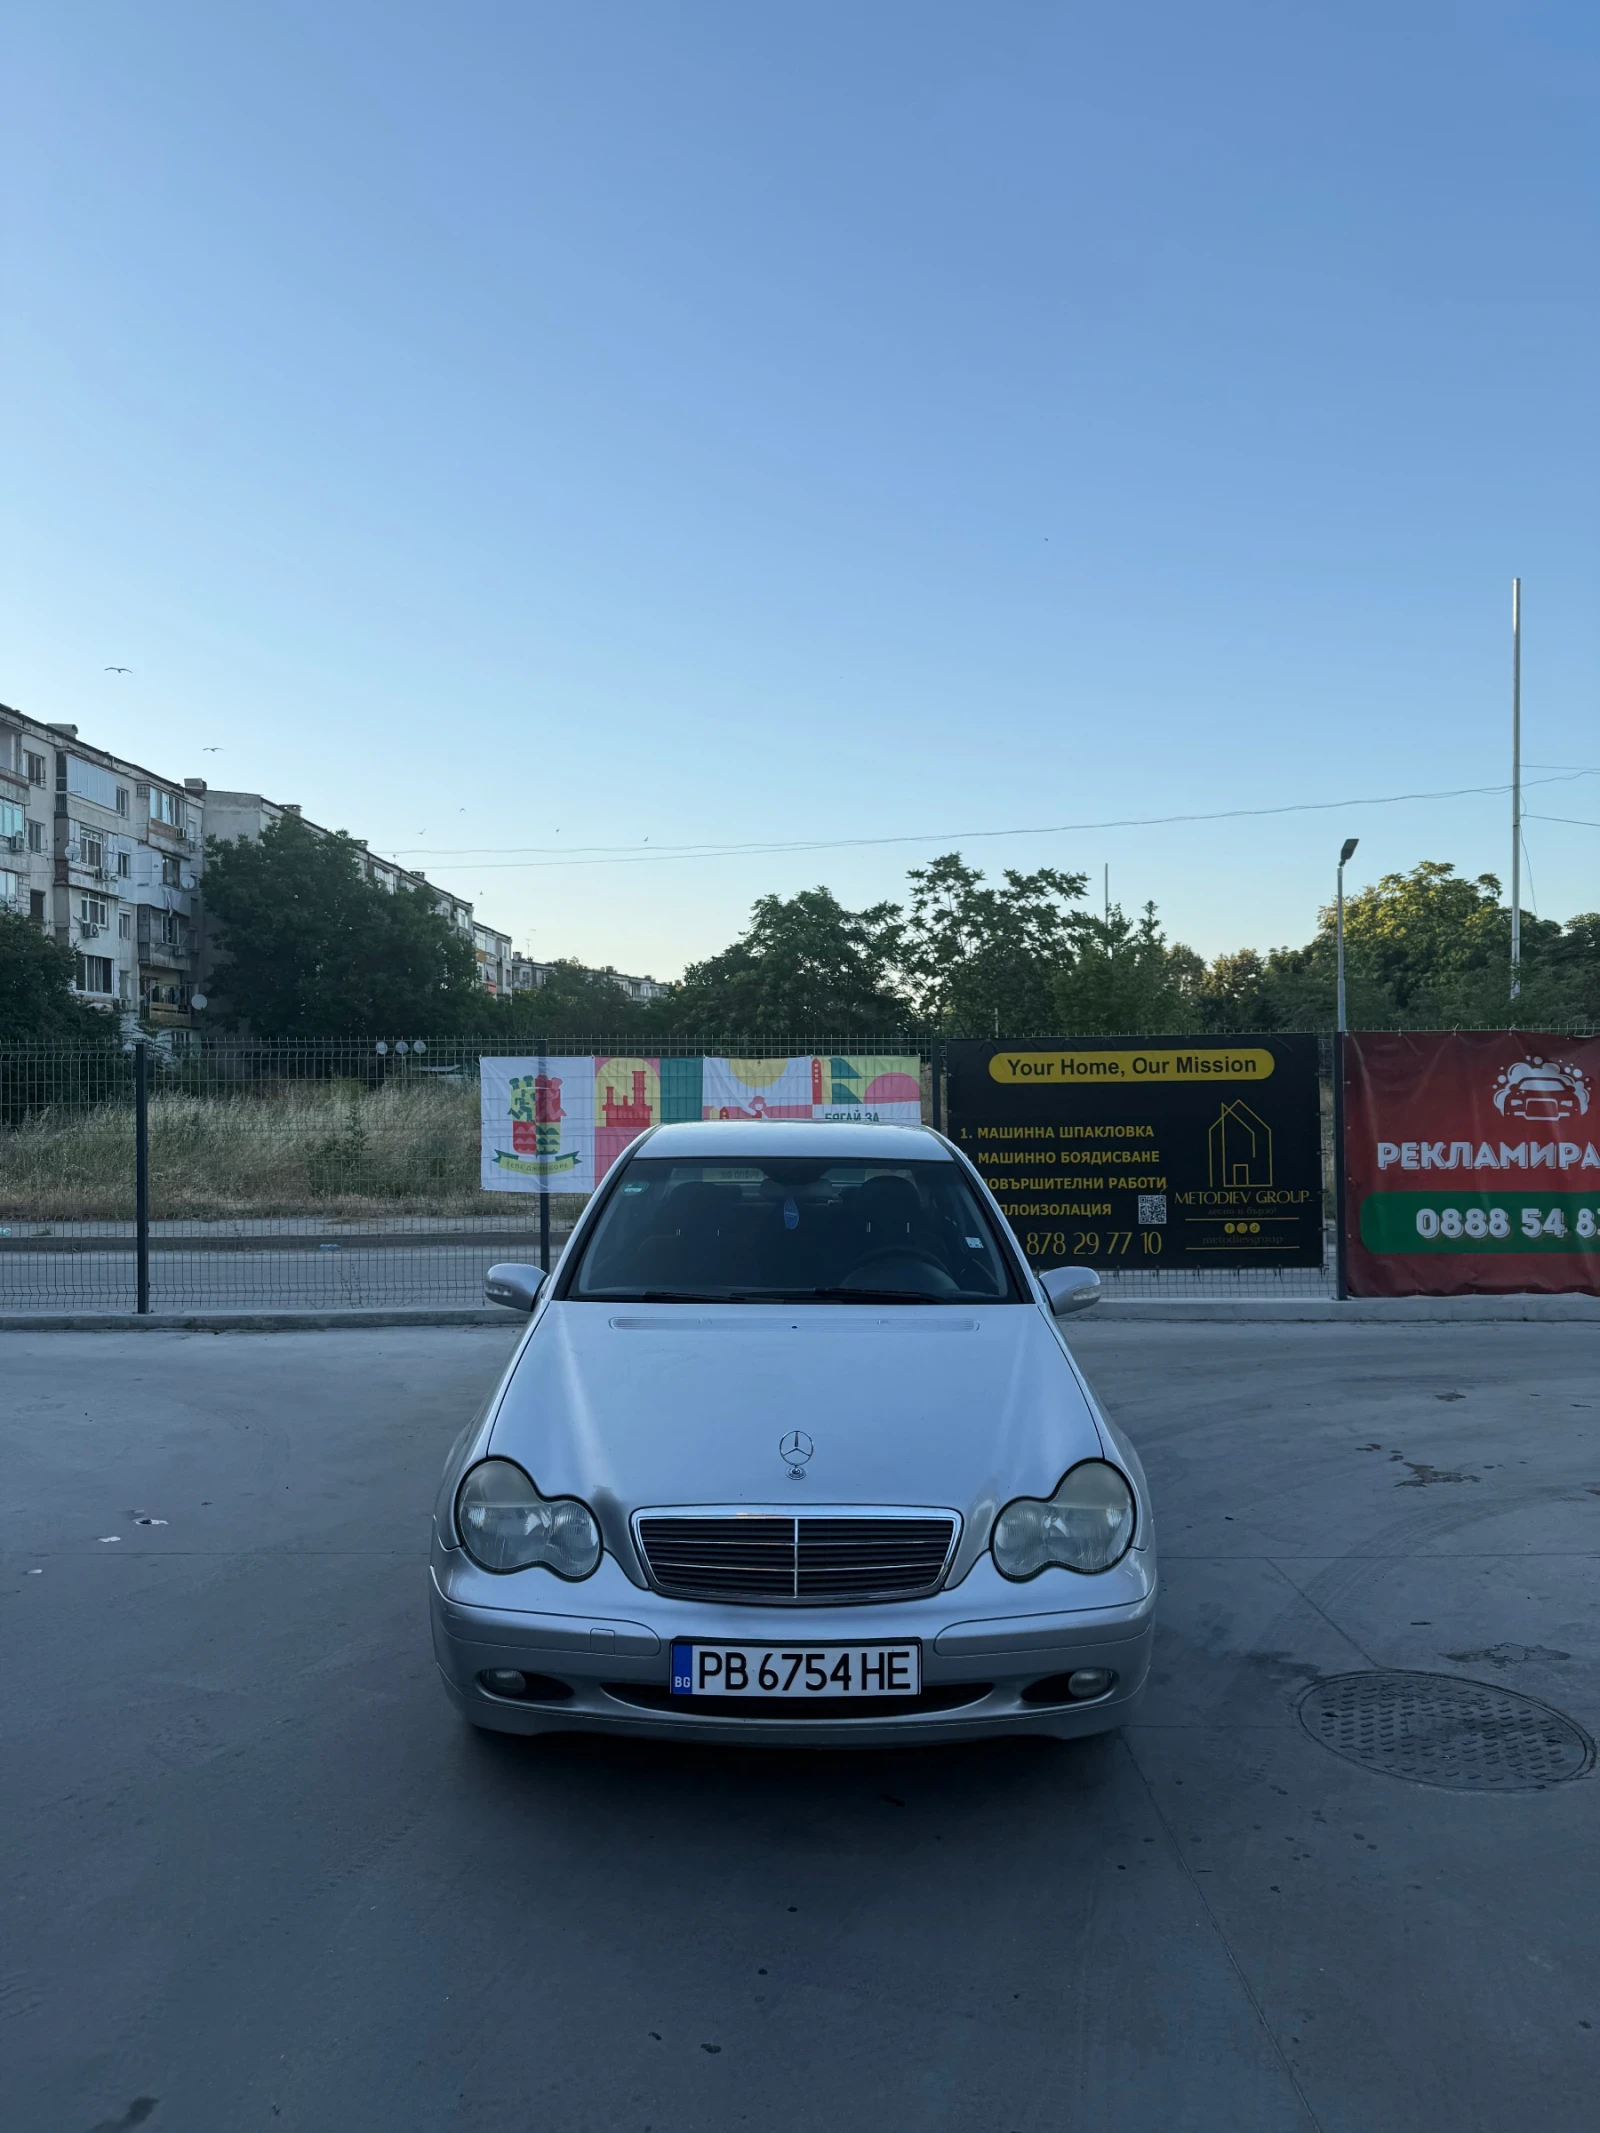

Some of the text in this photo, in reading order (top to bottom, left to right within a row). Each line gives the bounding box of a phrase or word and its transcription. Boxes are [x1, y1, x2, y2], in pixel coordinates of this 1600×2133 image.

[1007, 1055, 1257, 1078] Your Home, Our Mission
[960, 1125, 1154, 1139] 1. МАШИННА ШПАКЛОВКА
[977, 1151, 1056, 1164] МАШИННО
[1060, 1150, 1160, 1165] БОЯДИСВАНЕ
[1377, 1142, 1600, 1169] РЕКЛАМИРА
[984, 1176, 1167, 1191] ОВЪРШИТЕЛНИ РАБОТИ
[1174, 1189, 1310, 1205] METODIEV GROUP
[1416, 1208, 1600, 1239] 0888 54 8
[1026, 1231, 1066, 1256] 878
[1073, 1231, 1100, 1255] 29
[1106, 1231, 1133, 1255] 77
[1139, 1231, 1162, 1255] 10
[699, 1651, 911, 1691] PB 6754 HE
[674, 1675, 691, 1688] BG
